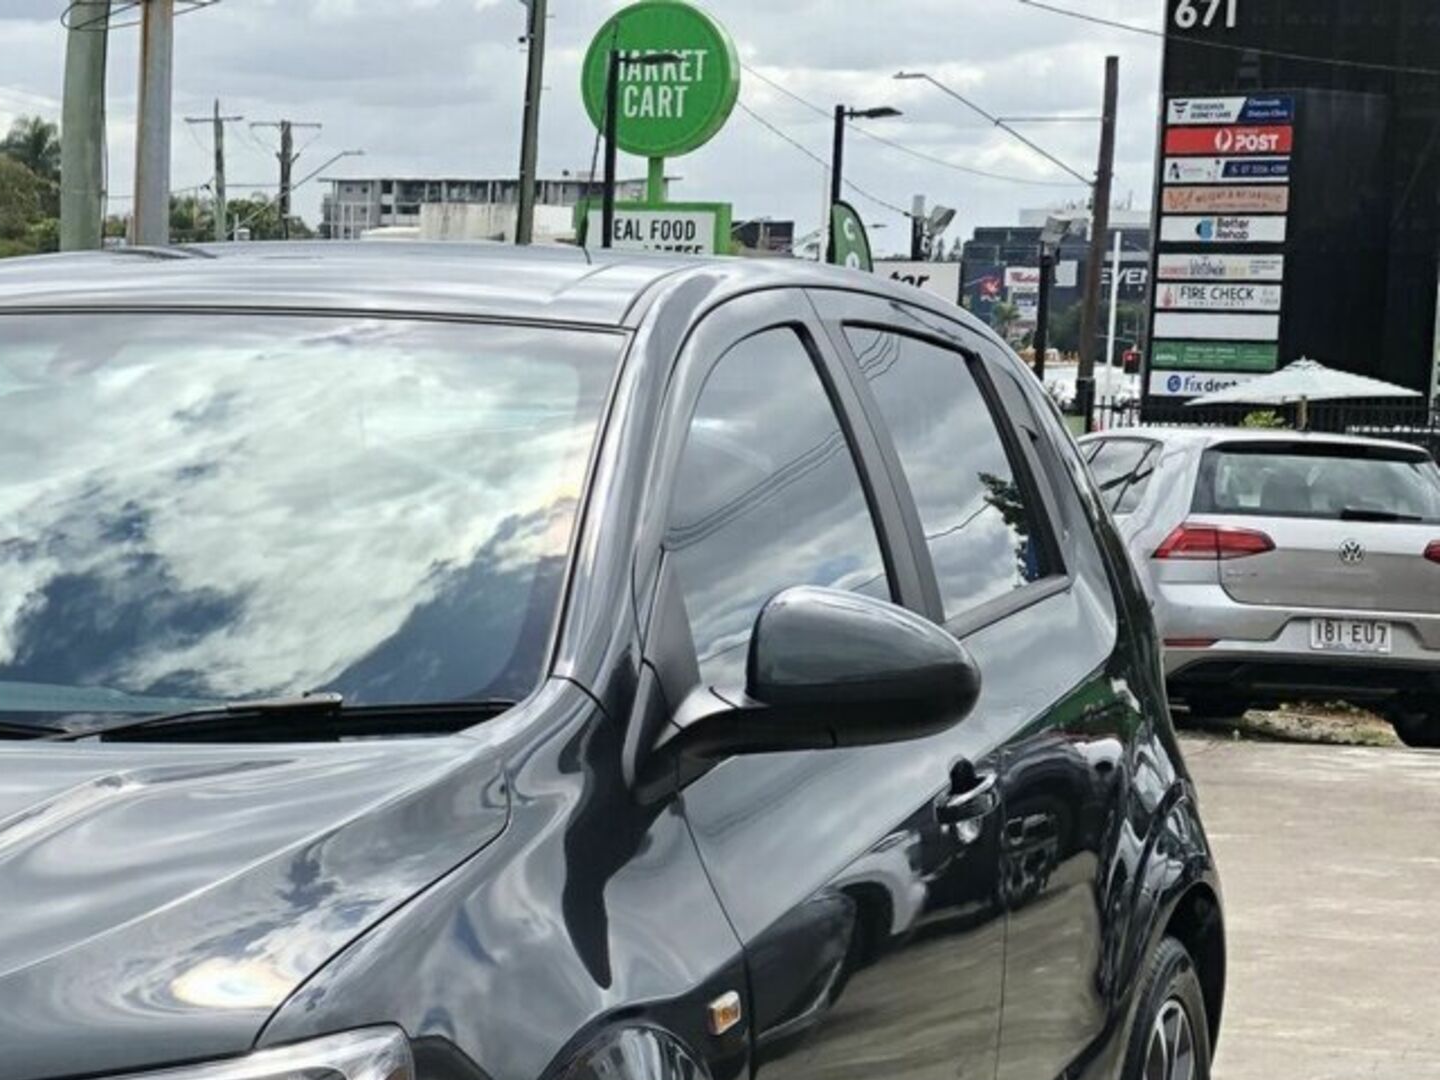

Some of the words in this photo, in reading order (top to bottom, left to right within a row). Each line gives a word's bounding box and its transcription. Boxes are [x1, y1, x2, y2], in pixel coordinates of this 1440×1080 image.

[623, 84, 689, 118] CART
[1234, 134, 1279, 152] POST
[613, 218, 644, 241] EAL
[650, 218, 697, 241] FOOD
[1180, 286, 1207, 299] FIRE
[1210, 287, 1254, 300] CHECK
